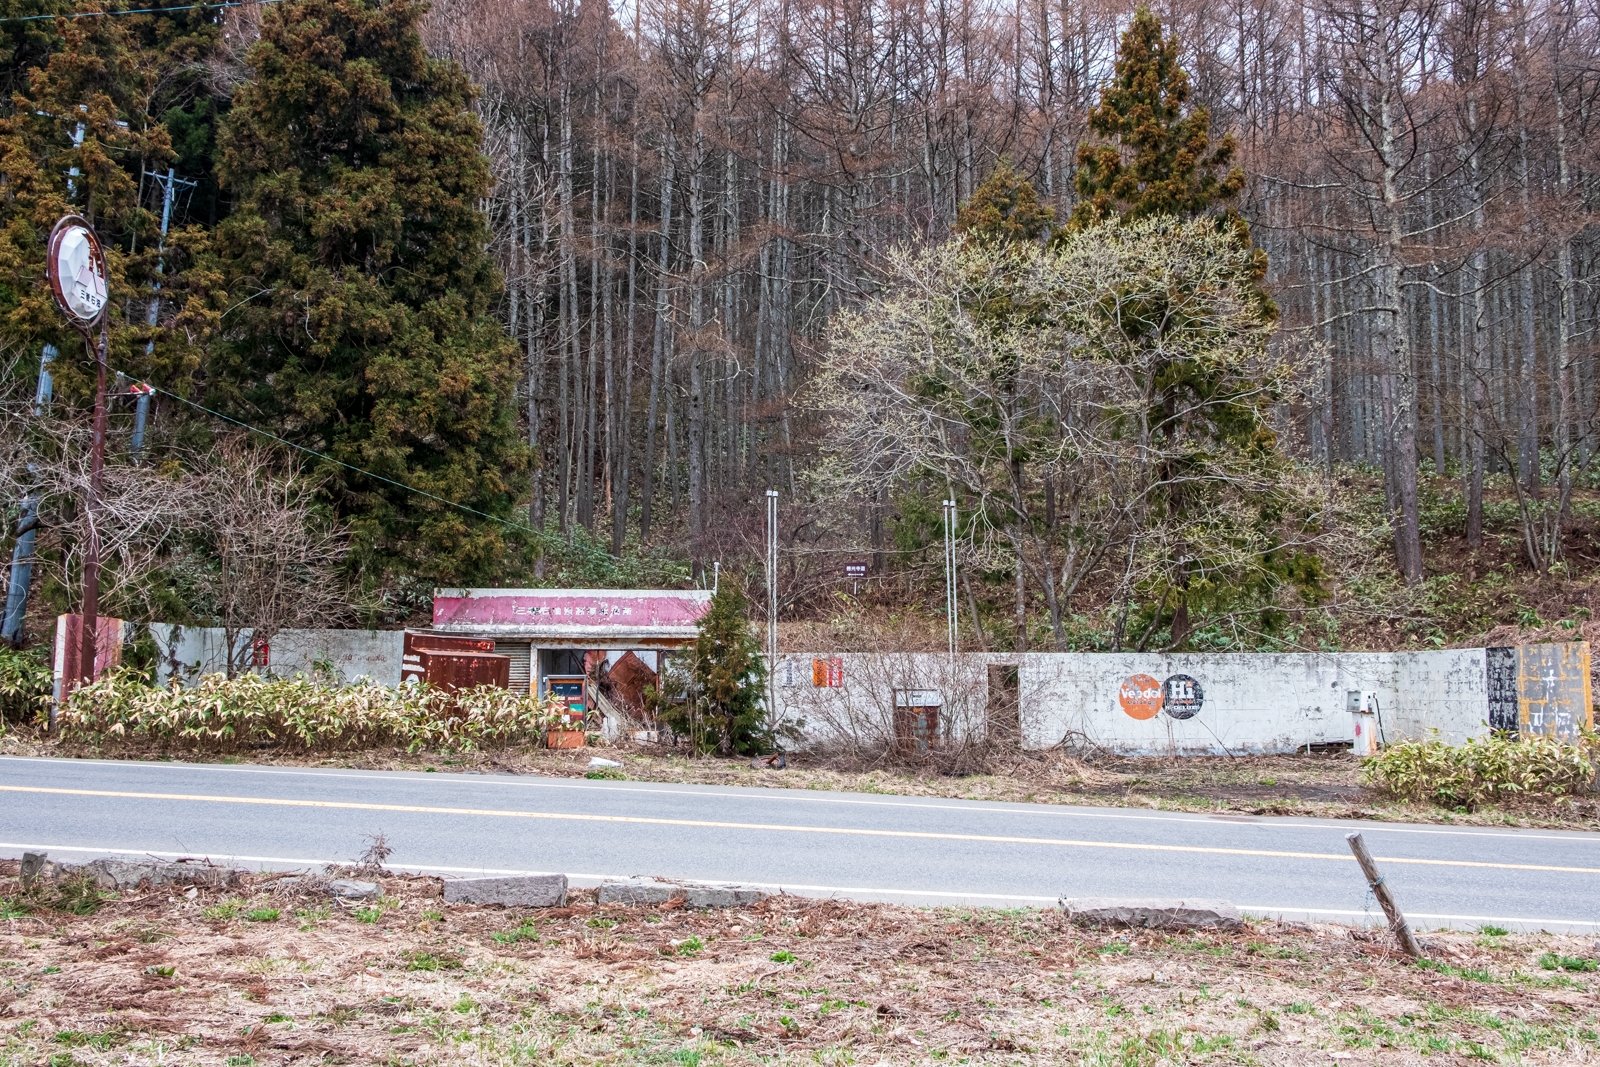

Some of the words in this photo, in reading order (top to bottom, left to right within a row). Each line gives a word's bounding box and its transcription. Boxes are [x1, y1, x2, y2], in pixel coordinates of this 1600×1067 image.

[80, 289, 101, 308] 三菱石油
[1121, 687, 1161, 699] Veedol
[1169, 680, 1195, 699] Hi
